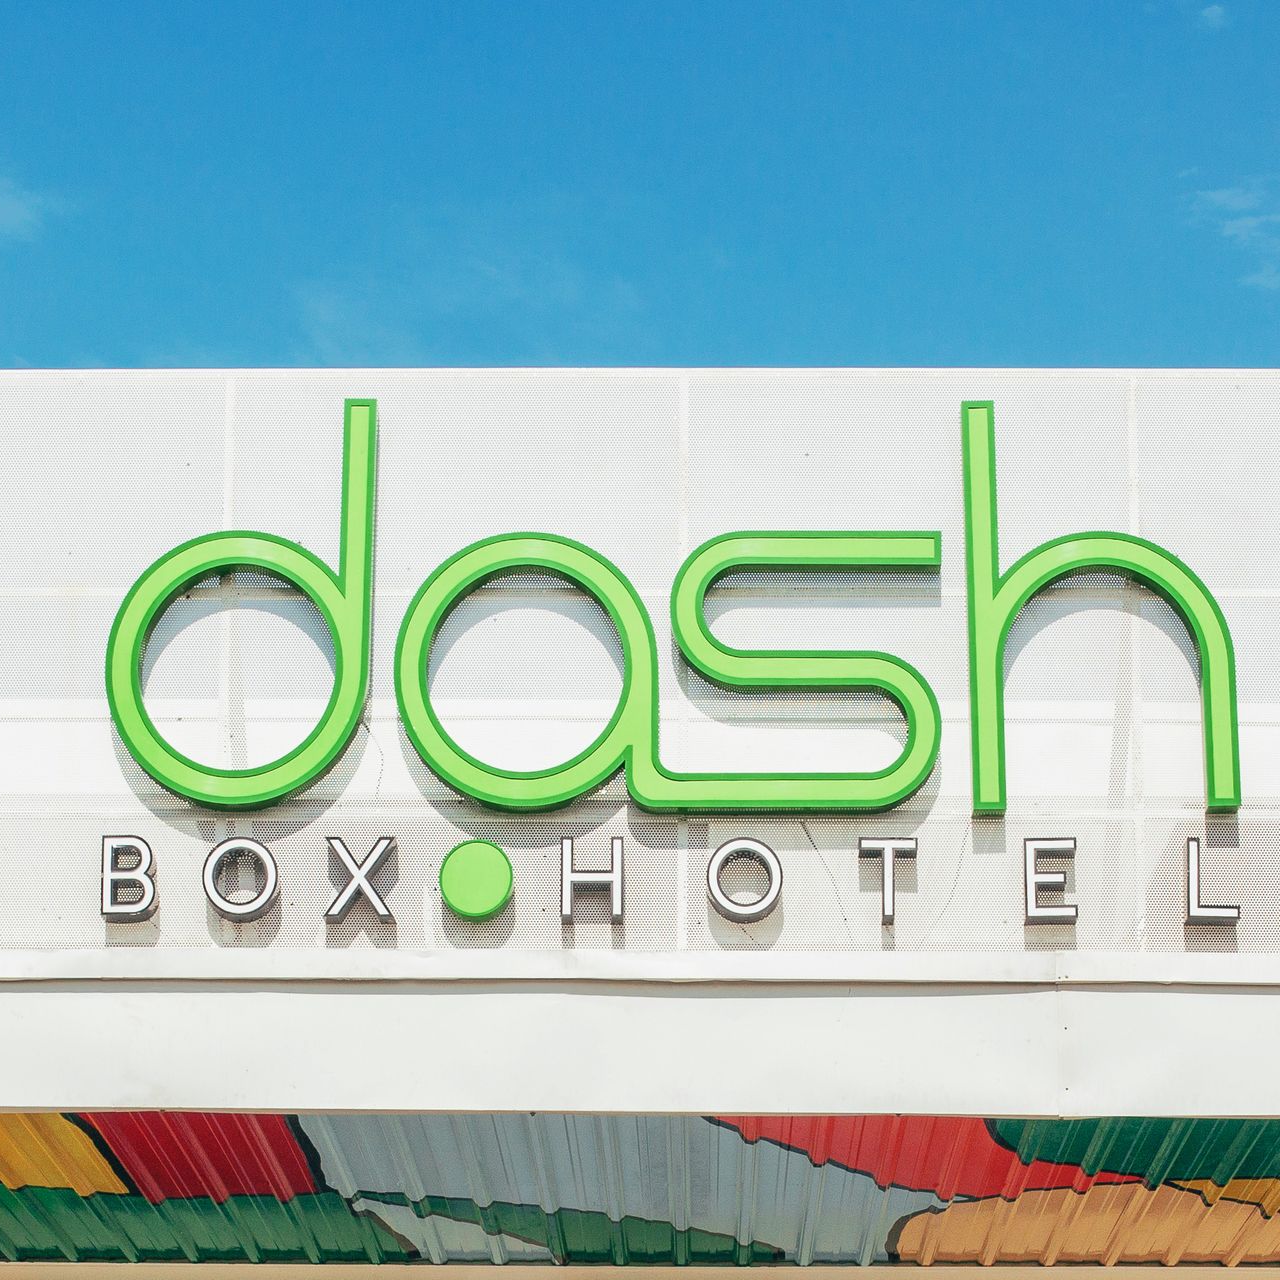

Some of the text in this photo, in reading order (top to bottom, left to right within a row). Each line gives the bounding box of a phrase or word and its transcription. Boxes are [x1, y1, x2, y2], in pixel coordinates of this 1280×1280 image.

[104, 397, 1241, 818] dash
[100, 834, 1242, 926] BOX HOTEL
